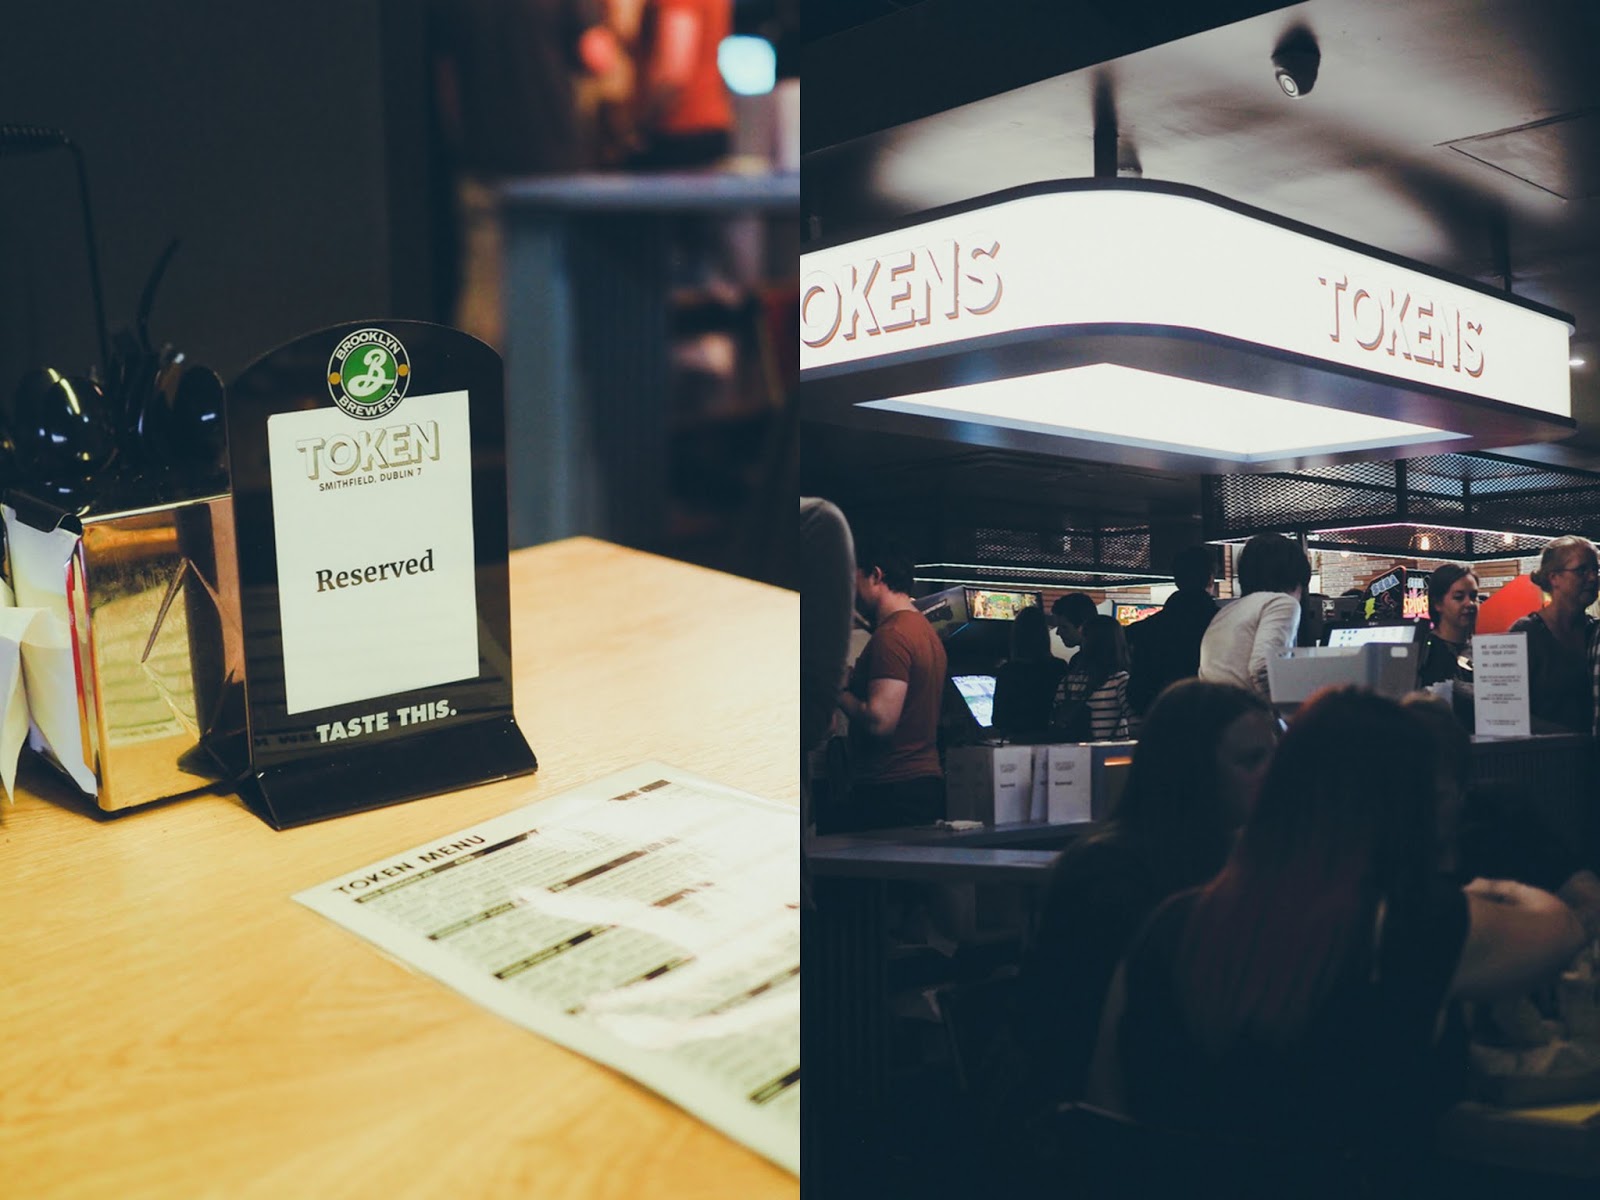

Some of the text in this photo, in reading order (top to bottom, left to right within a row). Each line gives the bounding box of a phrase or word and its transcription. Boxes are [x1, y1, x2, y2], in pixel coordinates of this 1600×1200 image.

[335, 332, 401, 360] BROOKLYN
[1317, 273, 1485, 378] TOKENS
[338, 388, 401, 416] BREWERY
[295, 419, 440, 481] TOKEN
[380, 469, 414, 483] DUBLIN
[315, 549, 435, 592] Reserved
[1371, 574, 1400, 597] SEGA
[316, 700, 457, 743] TASTE THIS.
[333, 862, 415, 894] TOKEN
[418, 835, 486, 863] MENU
